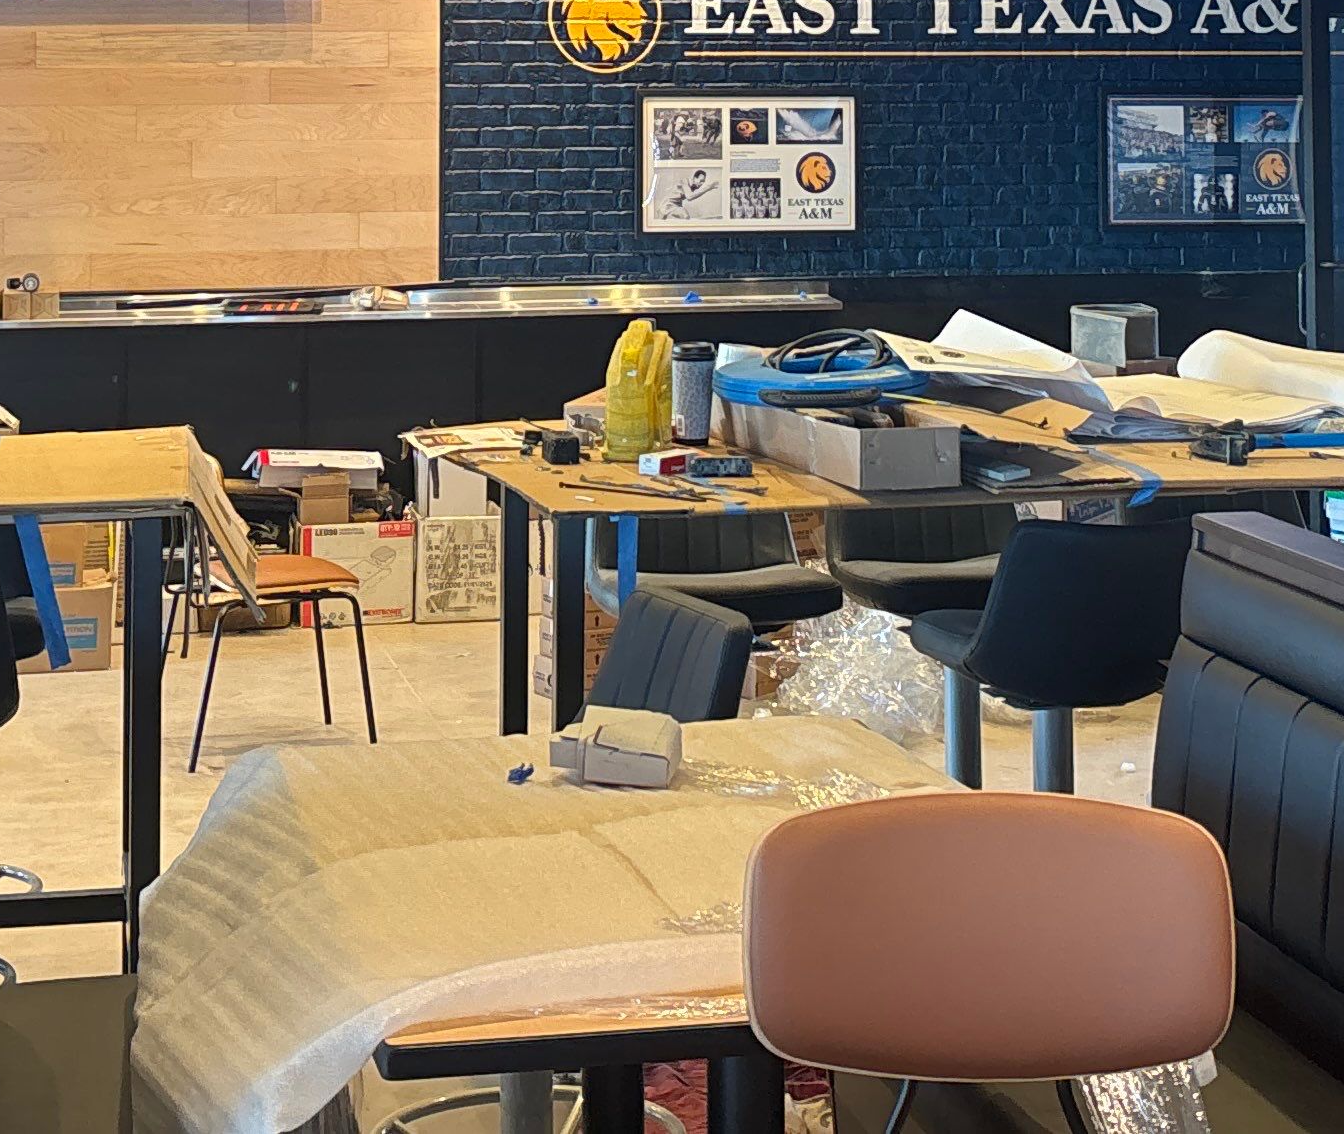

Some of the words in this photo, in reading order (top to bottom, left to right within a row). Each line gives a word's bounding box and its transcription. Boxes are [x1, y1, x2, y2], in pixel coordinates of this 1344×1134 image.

[788, 198, 812, 206] EAST
[813, 198, 844, 206] TEXAS
[1246, 194, 1269, 203] EAST
[1271, 194, 1300, 202] TEXAS
[798, 207, 832, 219] A&M
[1256, 203, 1289, 215] A&M
